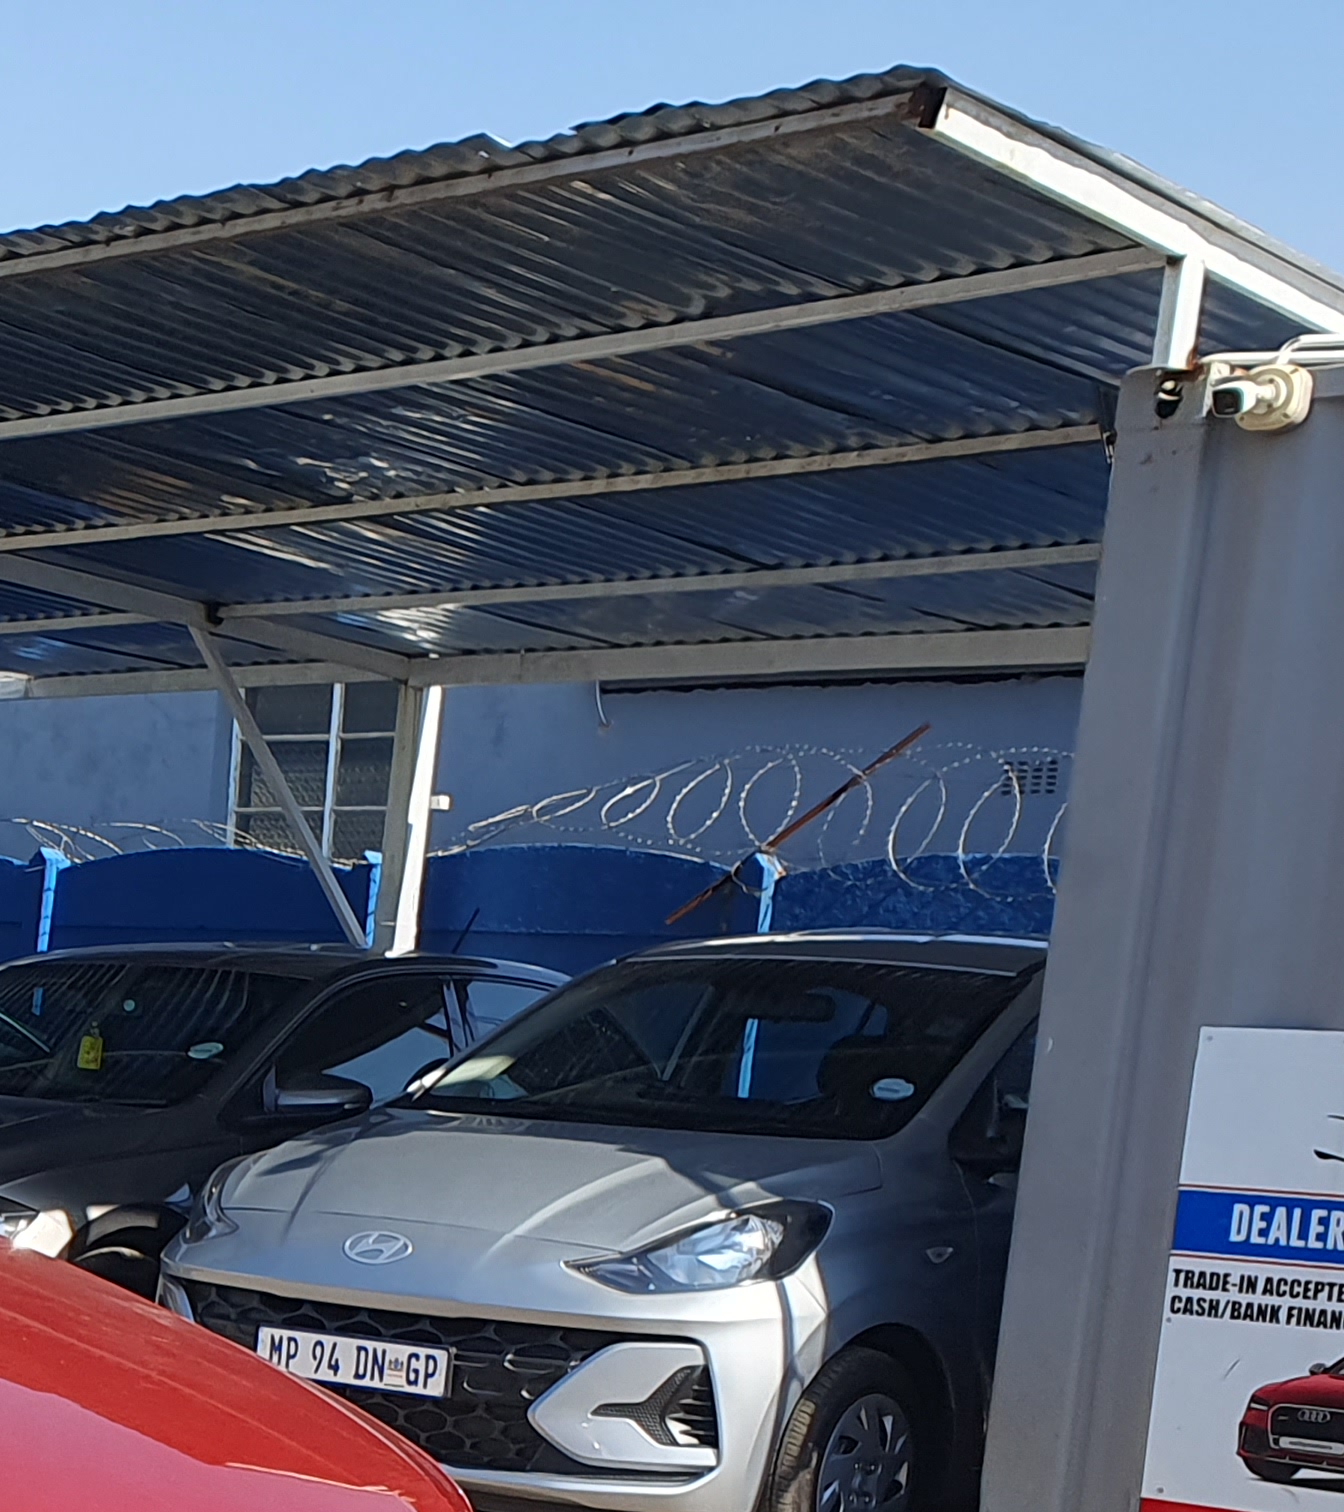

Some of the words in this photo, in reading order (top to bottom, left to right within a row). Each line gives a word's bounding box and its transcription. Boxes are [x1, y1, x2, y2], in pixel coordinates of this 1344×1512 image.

[1172, 1268, 1259, 1295] TRADE-IN
[1170, 1295, 1283, 1325] CASH/BANK
[269, 1333, 299, 1373] MP
[312, 1340, 340, 1377] 94
[353, 1345, 387, 1383] DN
[405, 1353, 438, 1390] GP
